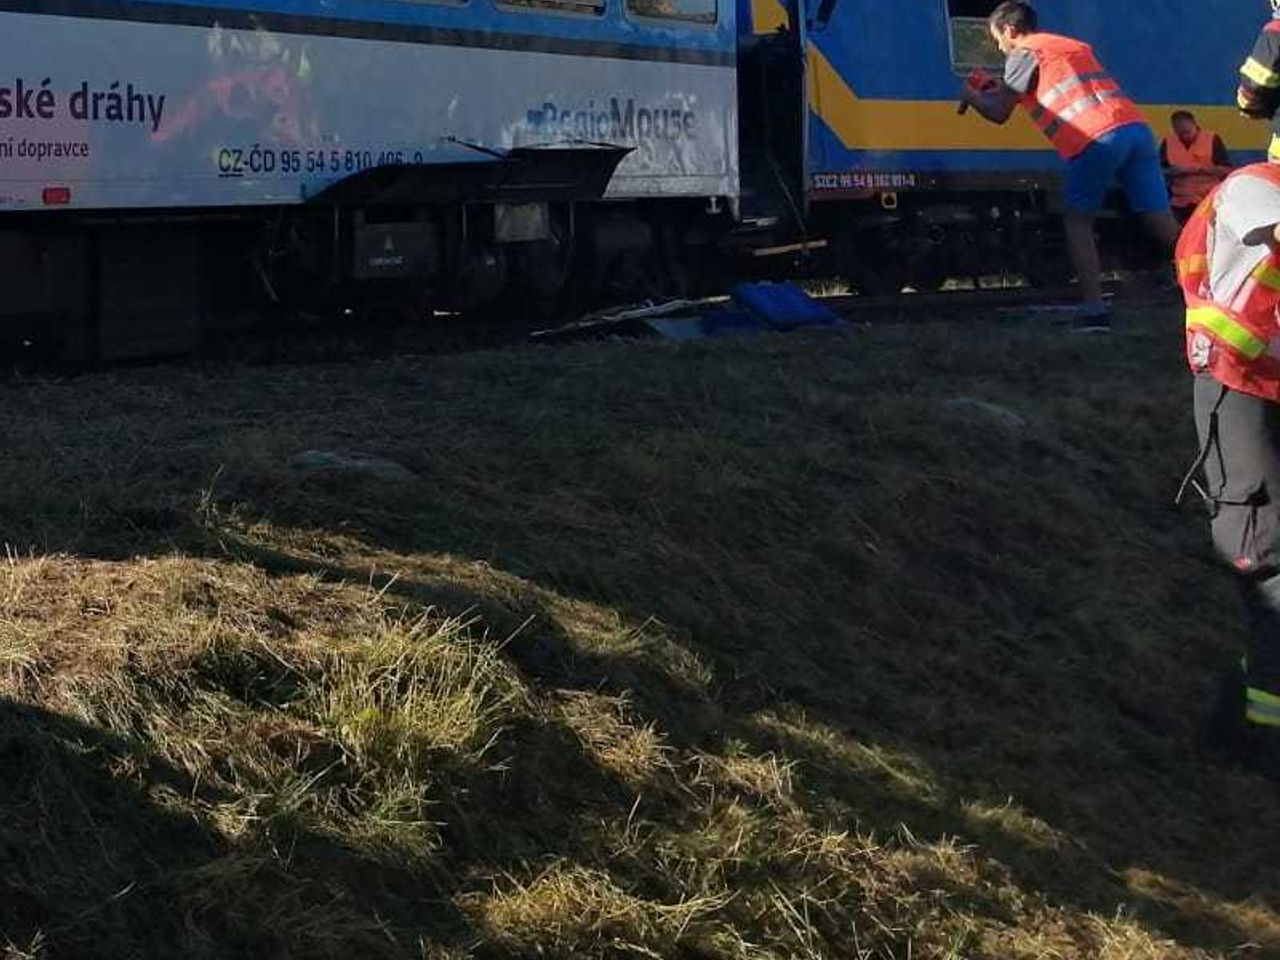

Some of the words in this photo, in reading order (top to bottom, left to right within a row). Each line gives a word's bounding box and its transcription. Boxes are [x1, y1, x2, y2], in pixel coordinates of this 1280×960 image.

[70, 81, 165, 132] dráhy
[18, 140, 89, 161] dopravce
[281, 150, 301, 173] 95
[306, 151, 325, 173] 54
[330, 151, 341, 173] 5
[344, 150, 372, 173] 810
